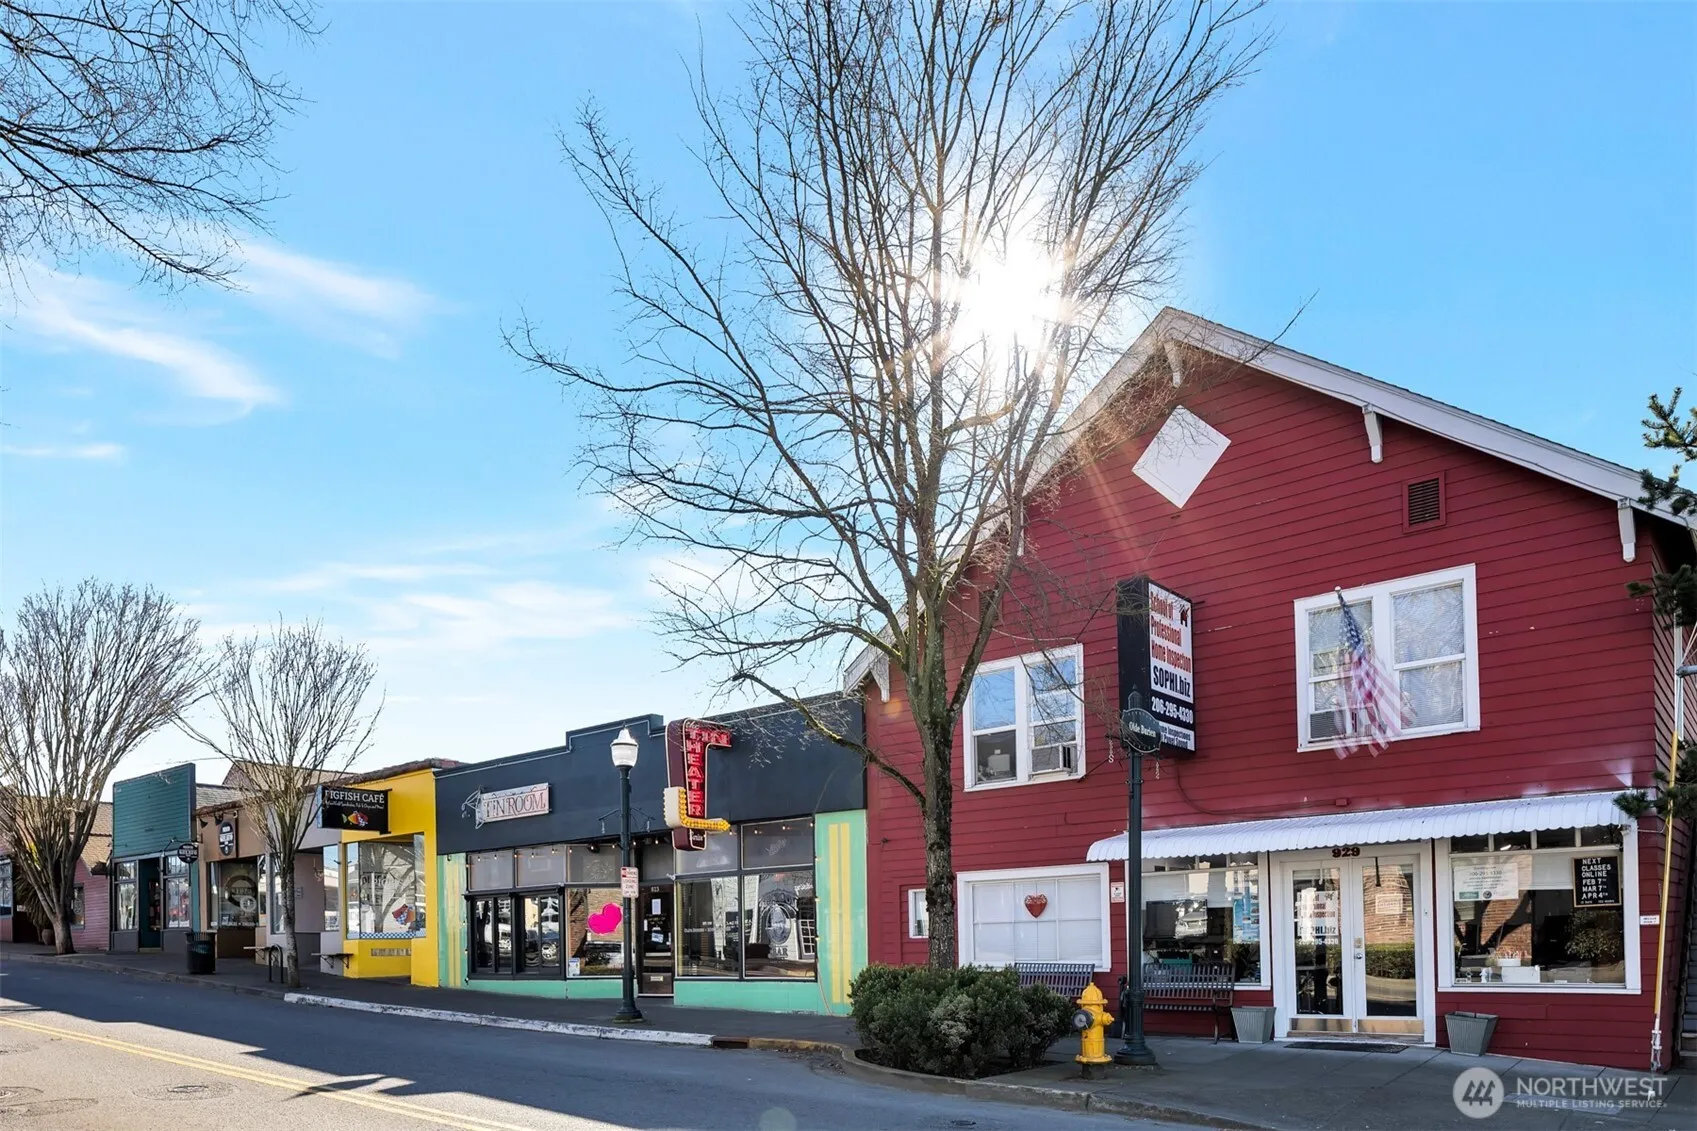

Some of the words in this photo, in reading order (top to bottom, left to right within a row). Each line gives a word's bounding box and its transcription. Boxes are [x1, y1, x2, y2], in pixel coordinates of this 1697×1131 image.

[1150, 591, 1167, 617] School
[1167, 601, 1173, 620] of
[1151, 615, 1182, 647] Professional
[1151, 639, 1166, 663] Home
[1166, 645, 1191, 673] Inspection
[1153, 665, 1190, 698] SOPHI.biz
[1151, 696, 1193, 724] 206-295-4330
[686, 727, 732, 745] TIN
[1128, 721, 1140, 734] Olde
[686, 728, 705, 816] THEATER
[362, 793, 385, 803] CAFÉ
[506, 792, 546, 816] ROOM
[1331, 846, 1361, 858] 929
[1582, 857, 1602, 865] NEXT
[1581, 892, 1597, 900] APR
